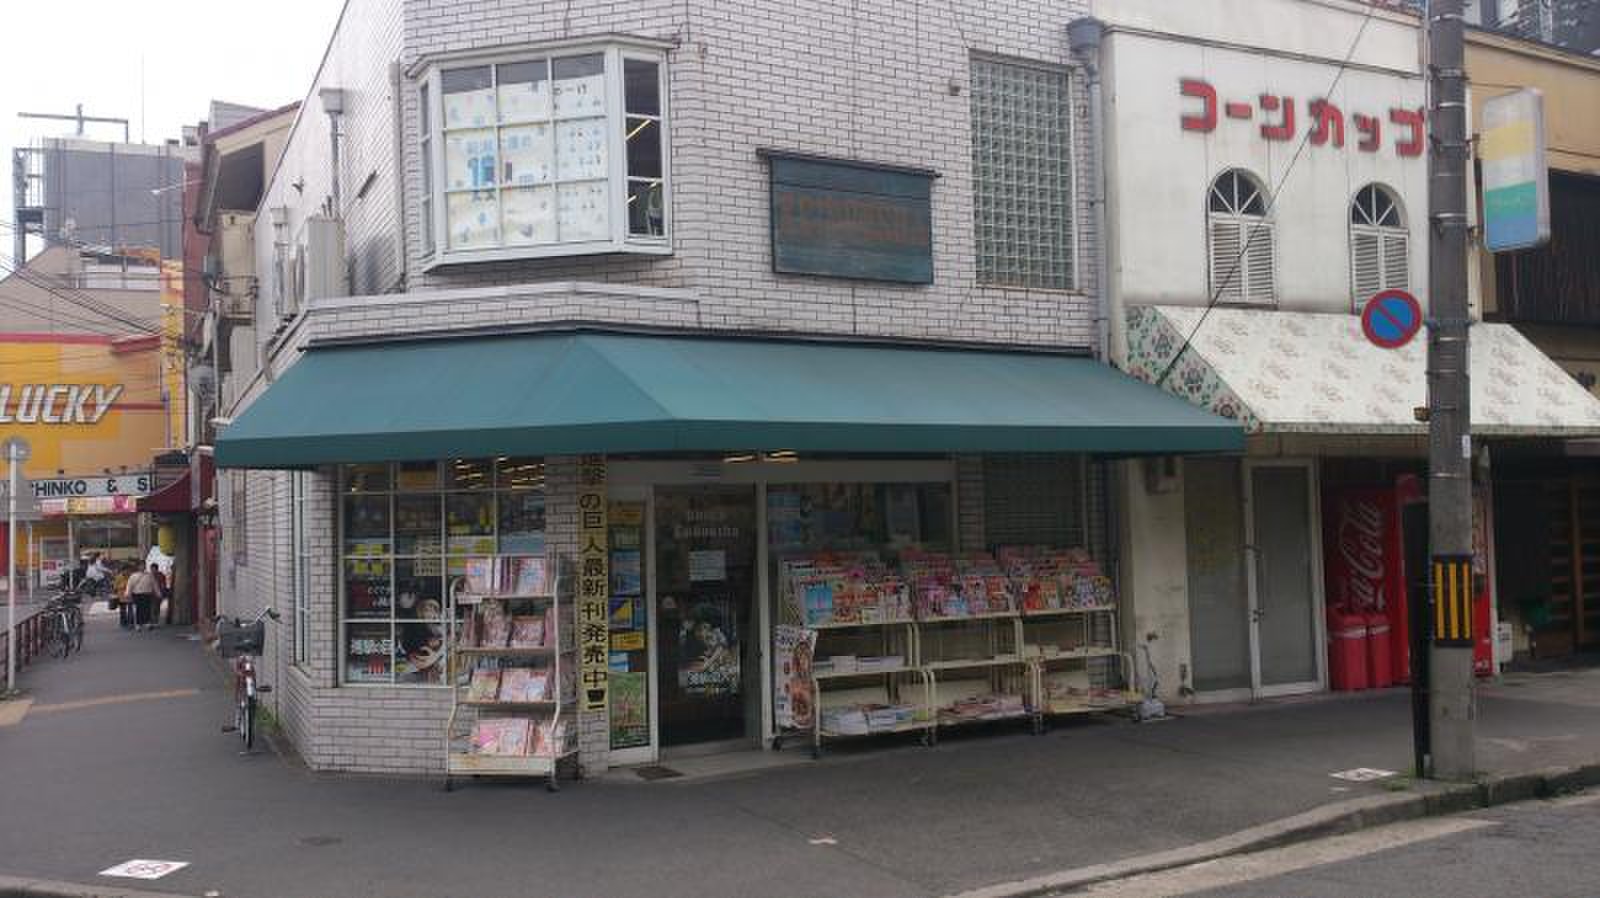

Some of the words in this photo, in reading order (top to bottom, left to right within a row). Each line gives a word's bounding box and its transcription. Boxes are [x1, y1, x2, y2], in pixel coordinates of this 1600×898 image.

[1180, 78, 1425, 157] コーンカップ
[0, 384, 124, 424] LUCKY
[32, 478, 88, 496] HINKO
